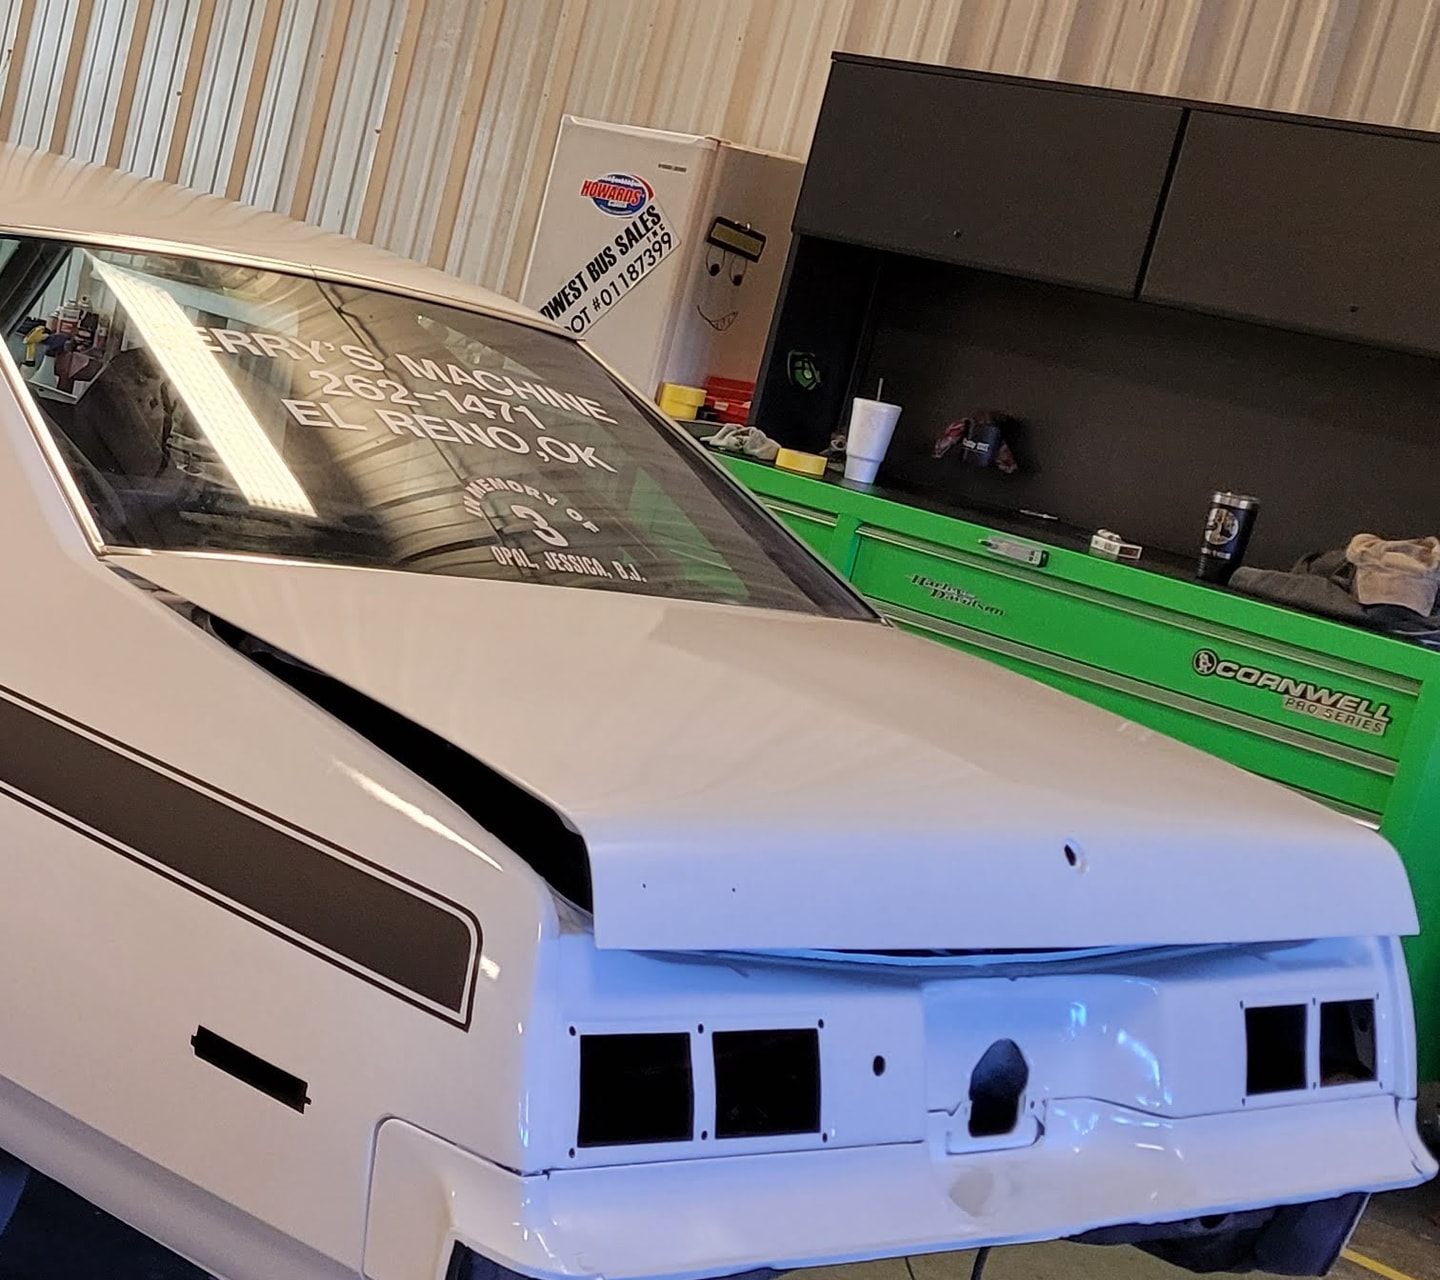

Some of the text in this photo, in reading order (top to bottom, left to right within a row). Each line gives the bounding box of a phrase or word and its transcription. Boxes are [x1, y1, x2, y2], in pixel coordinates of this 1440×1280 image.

[580, 179, 643, 206] HOWARDS
[586, 246, 617, 283] BUS
[614, 205, 661, 256] SALES
[564, 232, 672, 333] OT #01187399
[193, 326, 619, 425] ERRY'S MACHINE
[309, 370, 546, 430] 262-1471
[281, 398, 368, 431] EL
[464, 477, 600, 533] IN MEMORY OF
[510, 504, 569, 547] 3
[490, 545, 541, 570] OPAL,
[544, 551, 614, 579] JESSICA,
[1215, 660, 1391, 722] CORNWELL
[1285, 698, 1384, 733] PRO SERIES
